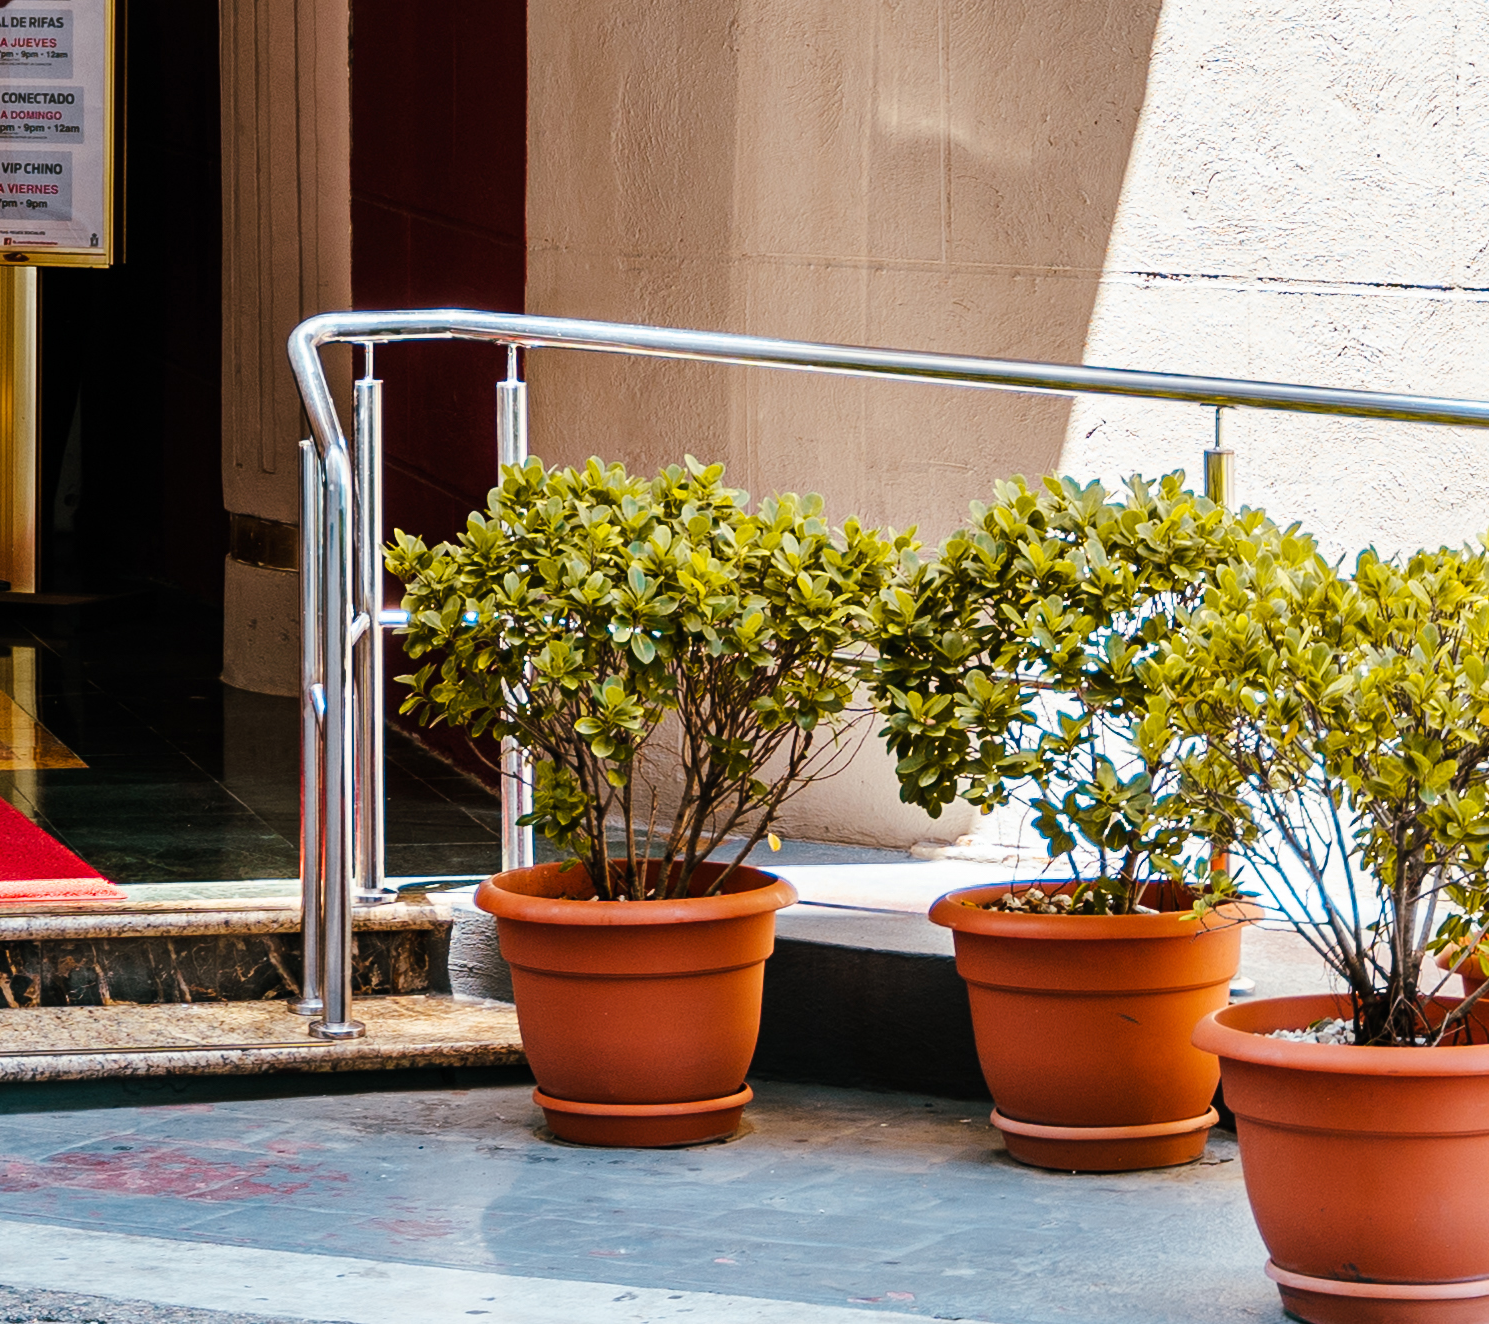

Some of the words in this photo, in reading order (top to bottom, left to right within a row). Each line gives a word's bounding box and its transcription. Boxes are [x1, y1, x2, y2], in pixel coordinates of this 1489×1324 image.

[10, 16, 27, 28] DE
[28, 16, 64, 29] RIFAS
[0, 37, 9, 48] A
[10, 37, 58, 49] JUEVES
[20, 50, 39, 59] 9pm
[46, 50, 68, 59] 12am
[1, 92, 75, 105] CONECTADO
[0, 109, 9, 120] A
[10, 110, 63, 120] DOMINGO
[23, 123, 45, 134] 9pm
[54, 123, 80, 133] 12am
[1, 161, 22, 174] VIP
[23, 162, 63, 175] CHINO
[7, 183, 59, 195] VIERNES
[25, 198, 48, 209] 9pm
